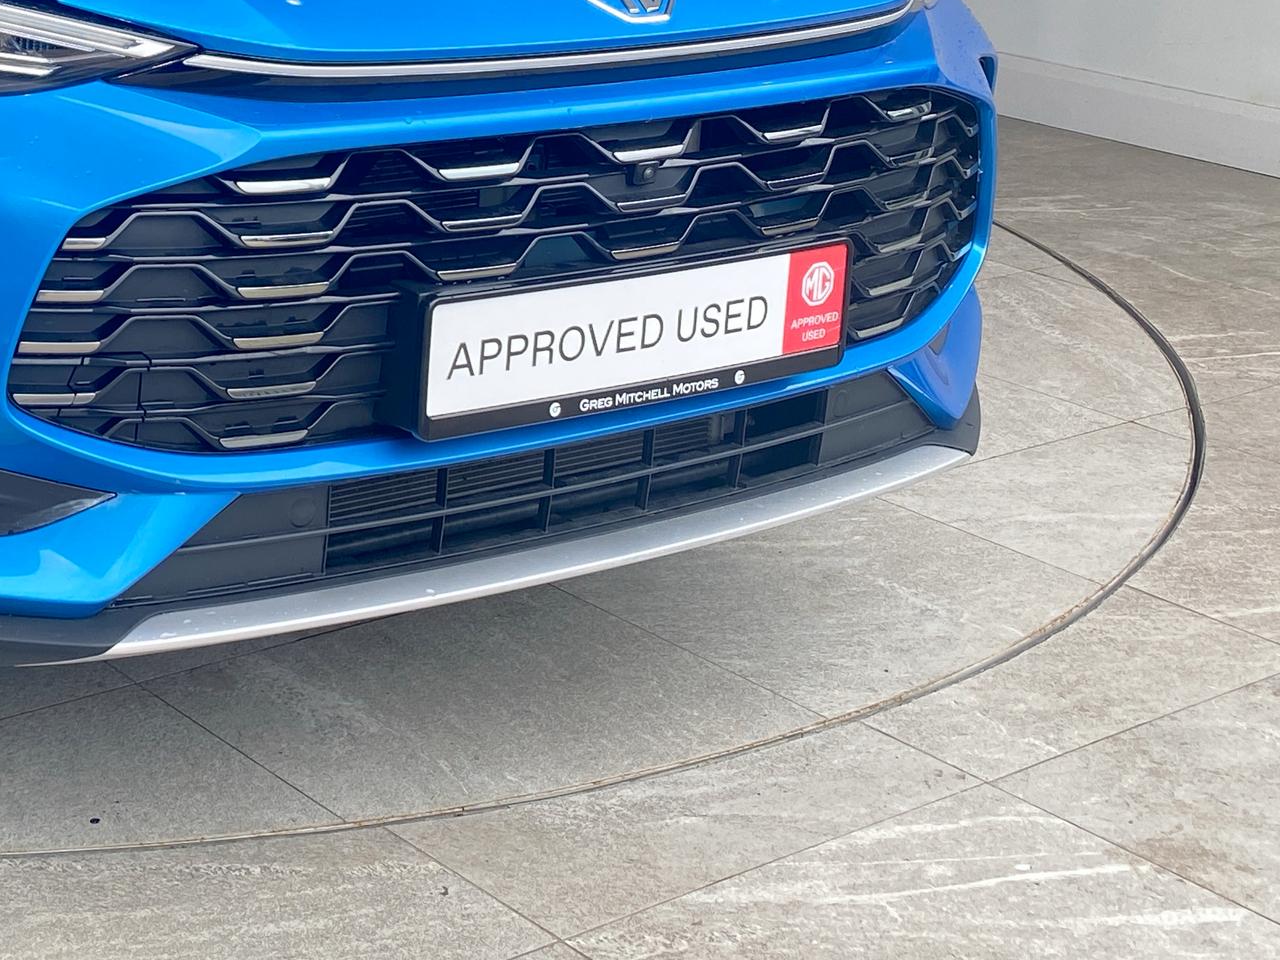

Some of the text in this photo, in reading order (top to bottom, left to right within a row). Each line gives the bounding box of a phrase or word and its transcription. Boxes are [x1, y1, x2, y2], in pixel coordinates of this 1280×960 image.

[805, 265, 832, 301] MG
[790, 311, 839, 330] APPROVED
[446, 295, 768, 381] APPROVED USED
[801, 328, 826, 342] USED
